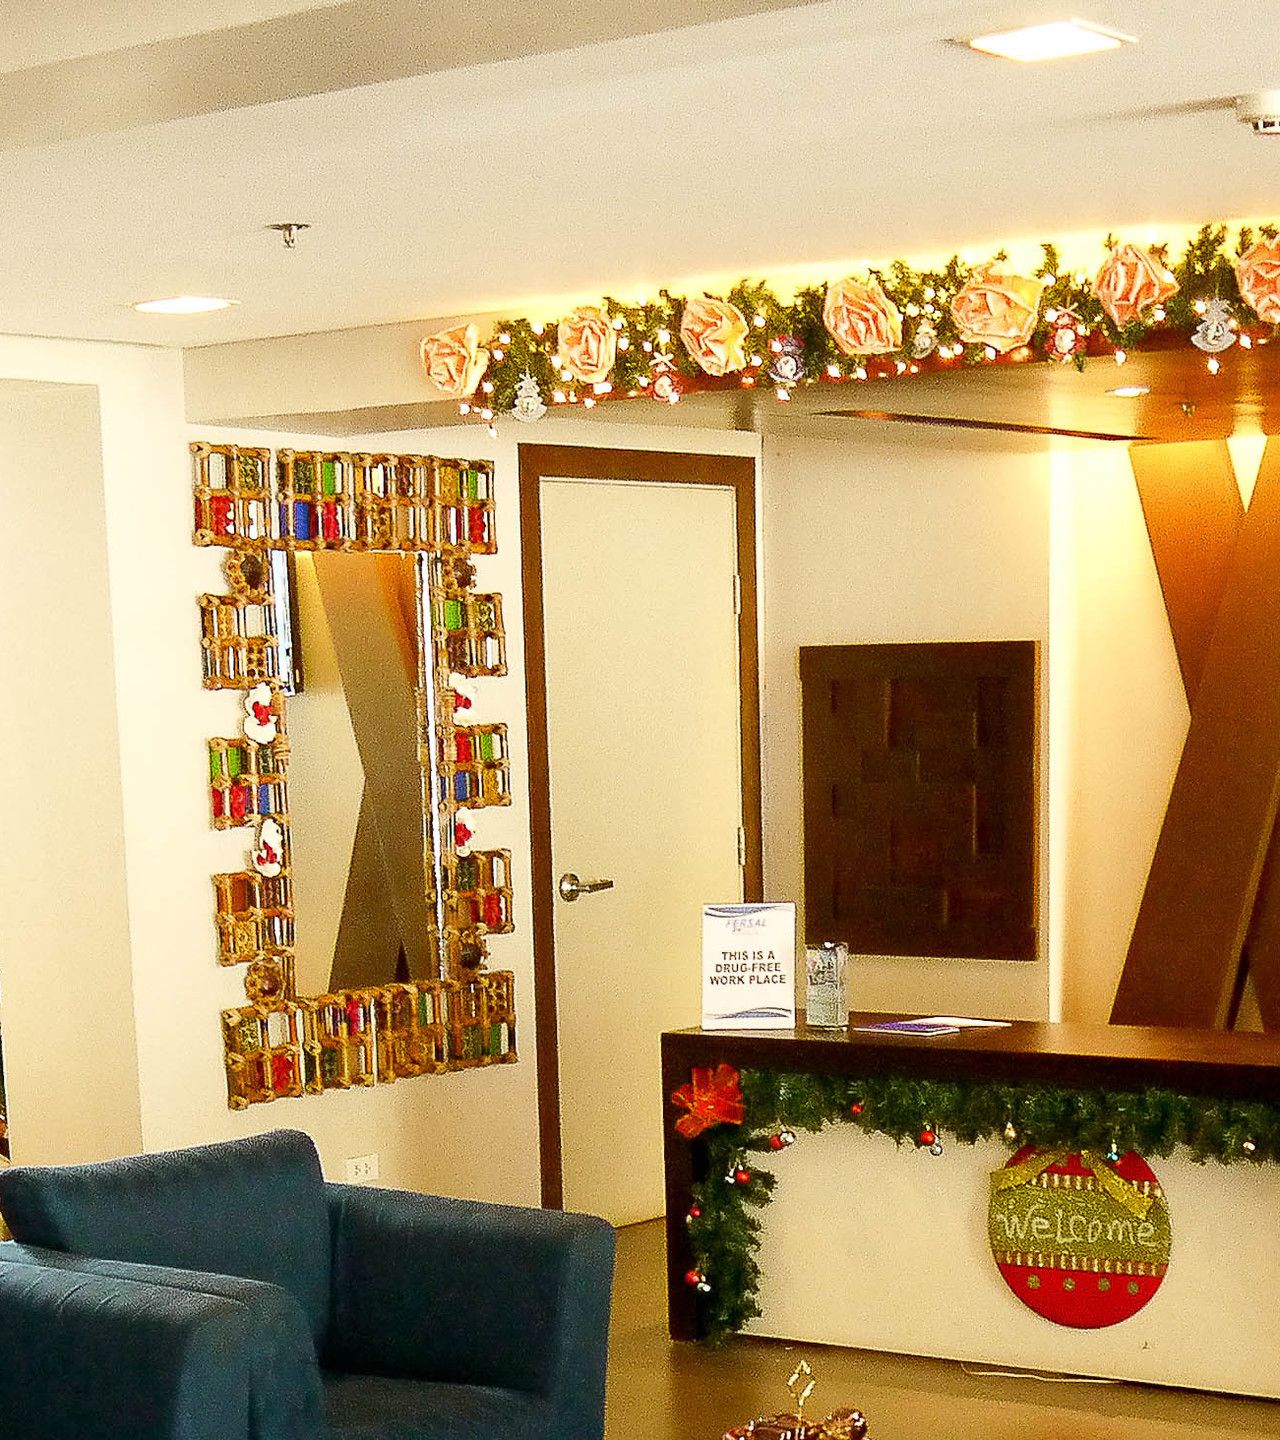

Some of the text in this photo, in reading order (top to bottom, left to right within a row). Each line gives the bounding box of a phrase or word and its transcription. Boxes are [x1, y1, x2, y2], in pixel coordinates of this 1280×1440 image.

[721, 950, 775, 961] THIS IS A
[715, 962, 782, 973] DRUG-FREE
[709, 973, 787, 986] WORK PLACE
